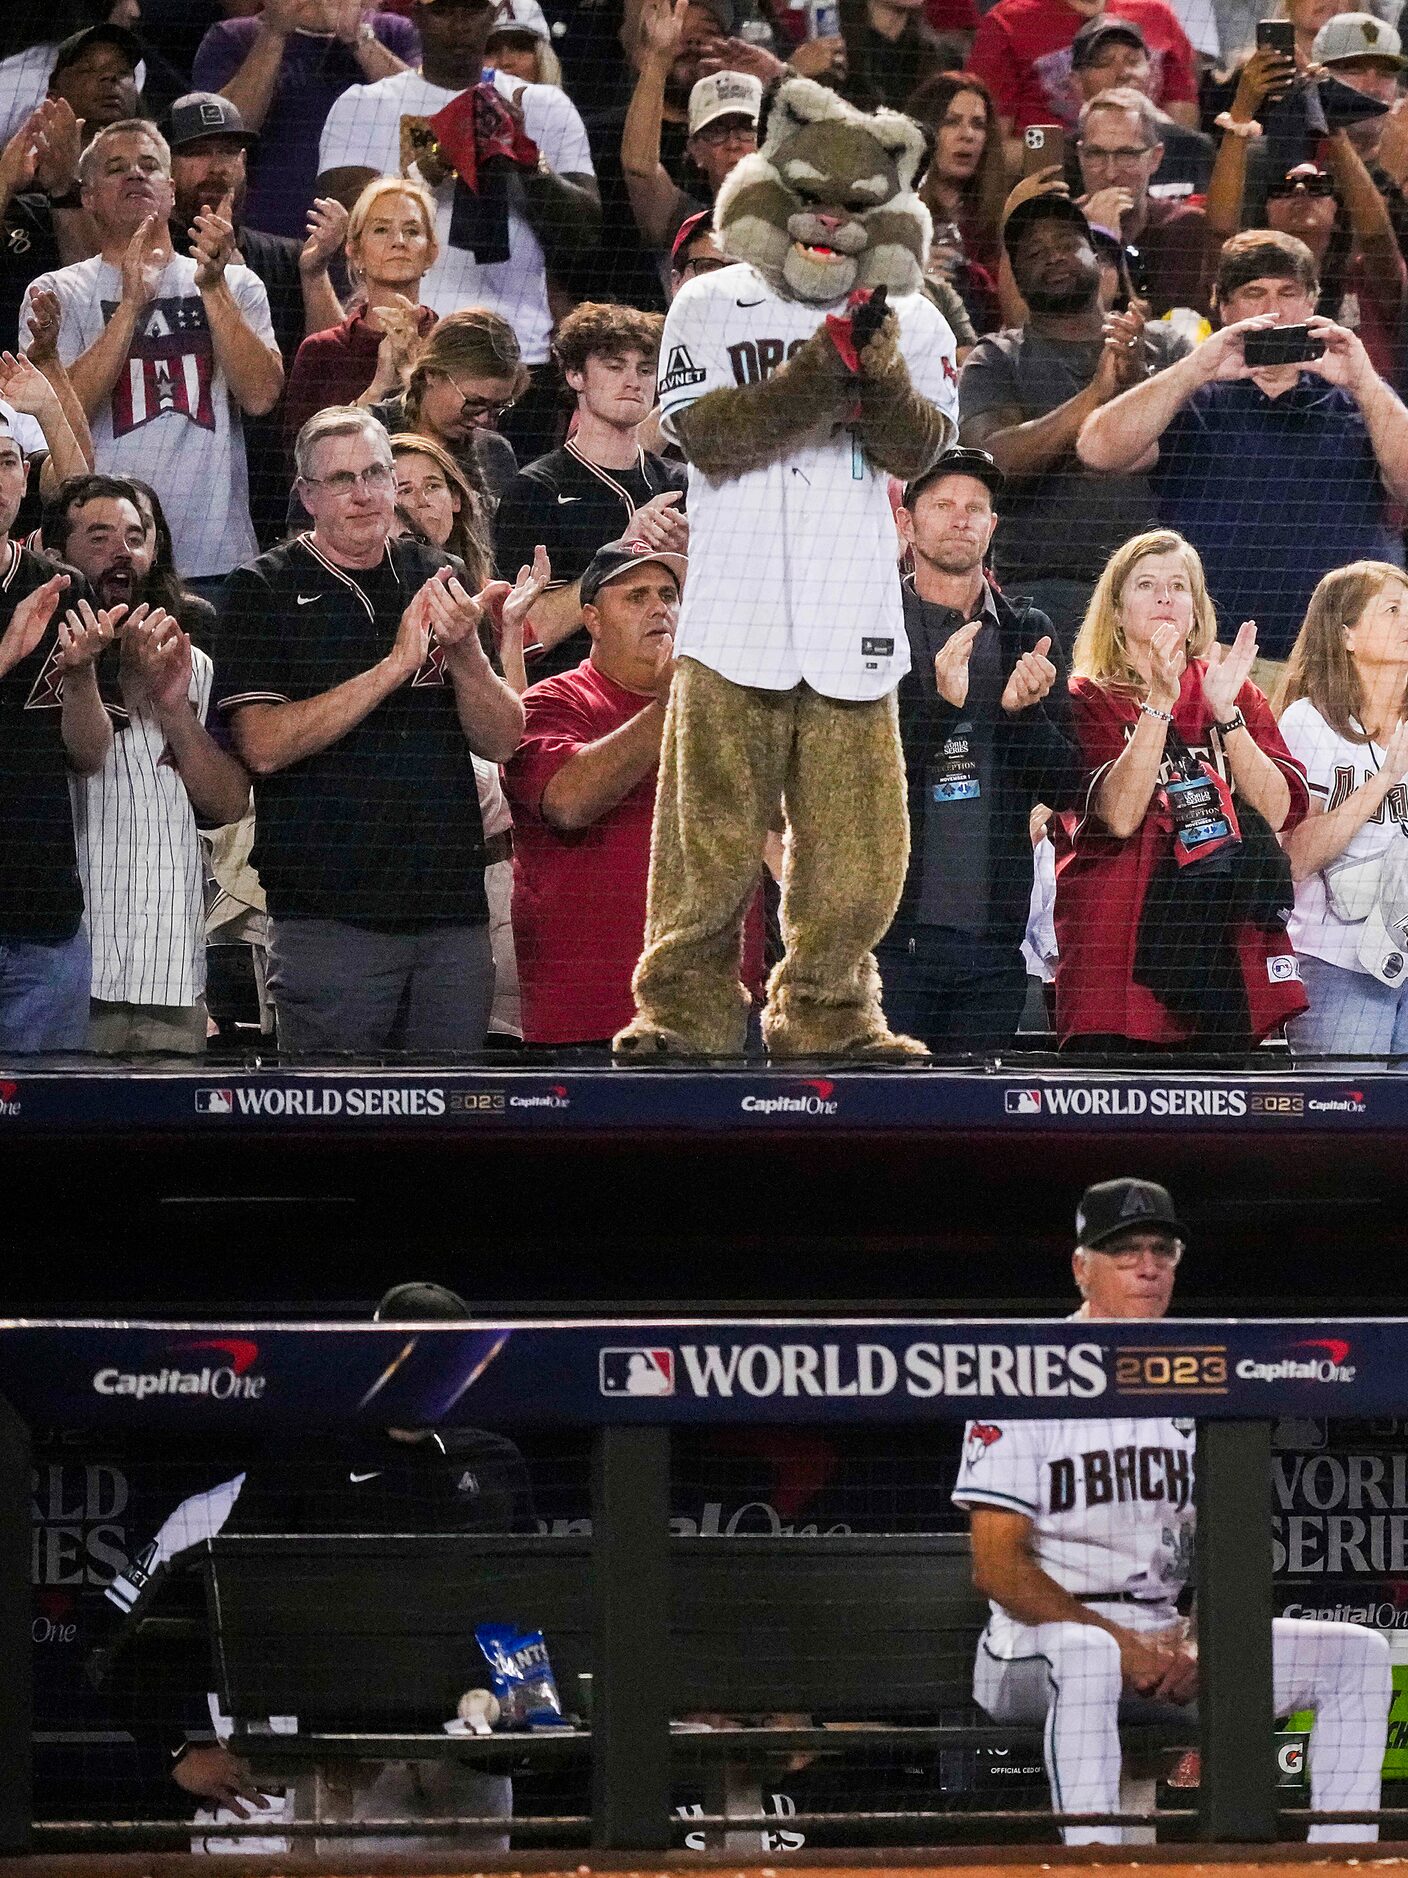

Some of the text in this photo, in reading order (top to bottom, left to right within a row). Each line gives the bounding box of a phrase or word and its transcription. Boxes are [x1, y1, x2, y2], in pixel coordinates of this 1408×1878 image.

[659, 368, 703, 393] AVNET
[944, 746, 969, 755] SERIES
[1186, 796, 1212, 806] SERIES
[236, 1088, 342, 1117] WORLD
[346, 1088, 446, 1117] SERIES
[450, 1094, 505, 1110] 2023
[1044, 1088, 1148, 1116] WORLD
[1151, 1088, 1247, 1117] SERIES
[1251, 1095, 1304, 1112] 2023
[678, 1344, 898, 1398] WORLD
[904, 1341, 1108, 1399] SERIES
[1115, 1356, 1229, 1385] 2023
